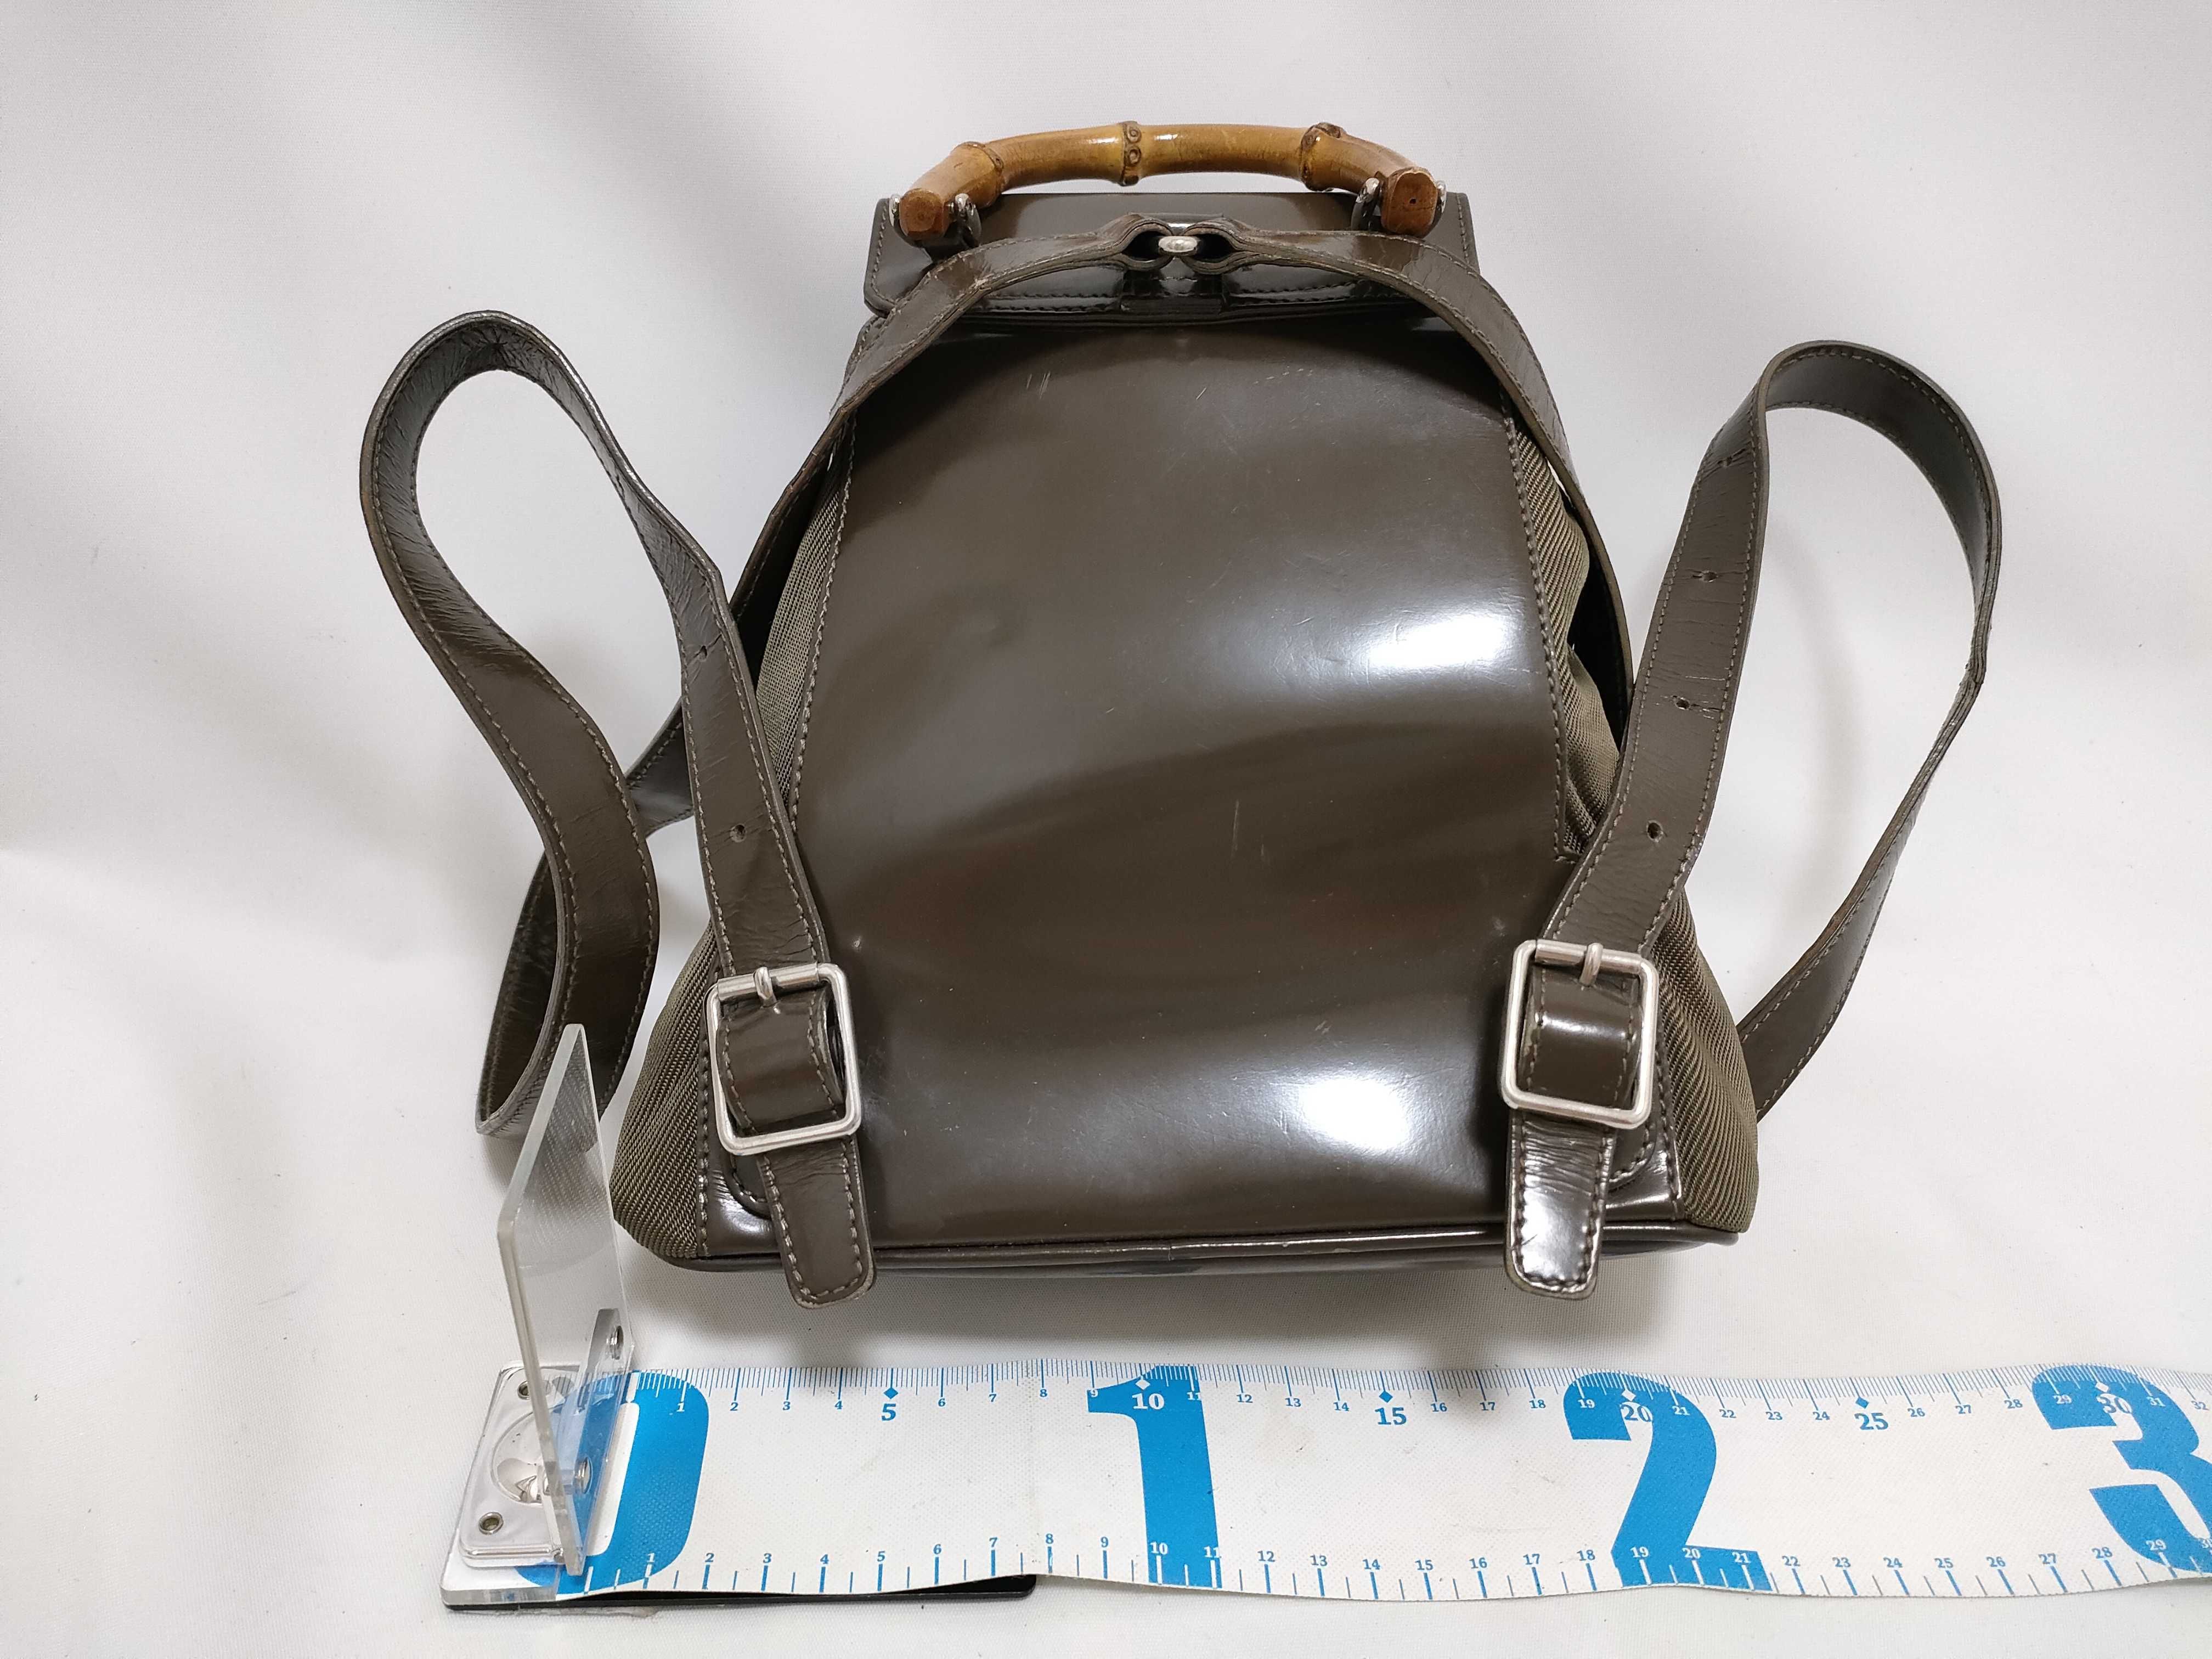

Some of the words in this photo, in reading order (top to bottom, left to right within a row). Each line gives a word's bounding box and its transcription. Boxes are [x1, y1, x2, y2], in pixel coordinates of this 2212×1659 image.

[676, 1401, 685, 1412] 1
[730, 1401, 738, 1412] 2
[782, 1401, 791, 1411] 3
[834, 1400, 843, 1410] 4
[881, 1403, 897, 1421] 5
[938, 1398, 946, 1407] 6
[989, 1393, 997, 1402] 7
[1040, 1389, 1048, 1398] 8
[1090, 1388, 1098, 1398] 9
[1132, 1393, 1165, 1410] 10
[1187, 1391, 1202, 1401] 11
[1237, 1393, 1254, 1403] 12
[1285, 1397, 1302, 1407] 13
[1333, 1401, 1350, 1412] 14
[1375, 1407, 1407, 1425] 15
[1430, 1402, 1448, 1413] 16
[1479, 1401, 1496, 1411] 17
[1529, 1399, 1547, 1409] 18
[1578, 1399, 1595, 1409] 19
[1621, 1402, 1652, 1423] 20
[1672, 1406, 1690, 1416] 21
[1719, 1408, 1736, 1419] 22
[1765, 1411, 1783, 1421] 23
[1812, 1411, 1830, 1421] 24
[1854, 1413, 1889, 1430] 25
[1908, 1408, 1926, 1418] 26
[1955, 1404, 1972, 1415] 27
[2004, 1399, 2023, 1409] 28
[2053, 1394, 2072, 1404] 29
[2097, 1393, 2134, 1414] 30
[2147, 1396, 2166, 1407] 31
[2191, 1400, 2210, 1410] 32
[1086, 1365, 1222, 1588] 1
[1563, 1371, 1773, 1592] 2
[2031, 1364, 2212, 1574] 3
[647, 1552, 656, 1563] 1
[706, 1553, 714, 1564] 2
[763, 1553, 772, 1564] 3
[820, 1553, 830, 1564] 4
[877, 1551, 886, 1562] 5
[933, 1544, 942, 1555] 6
[989, 1537, 998, 1548] 7
[1045, 1533, 1054, 1544] 8
[1100, 1536, 1109, 1548] 9
[1149, 1542, 1169, 1554] 10
[1203, 1546, 1221, 1558] 11
[1257, 1550, 1276, 1562] 12
[1310, 1554, 1328, 1567] 13
[1362, 1558, 1381, 1571] 14
[1415, 1559, 1434, 1571] 15
[1469, 1558, 1488, 1570] 16
[1523, 1553, 1542, 1565] 17
[1577, 1549, 1595, 1561] 18
[1630, 1546, 1650, 1558] 19
[1683, 1547, 1701, 1559] 20
[1732, 1551, 1751, 1564] 21
[1781, 1555, 1801, 1567] 22
[1832, 1557, 1851, 1568] 23
[1883, 1557, 1903, 1568] 24
[1934, 1557, 1954, 1568] 25
[1987, 1556, 2006, 1568] 26
[2038, 1553, 2057, 1565] 27
[2091, 1547, 2113, 1559] 28
[2146, 1539, 2167, 1551] 29
